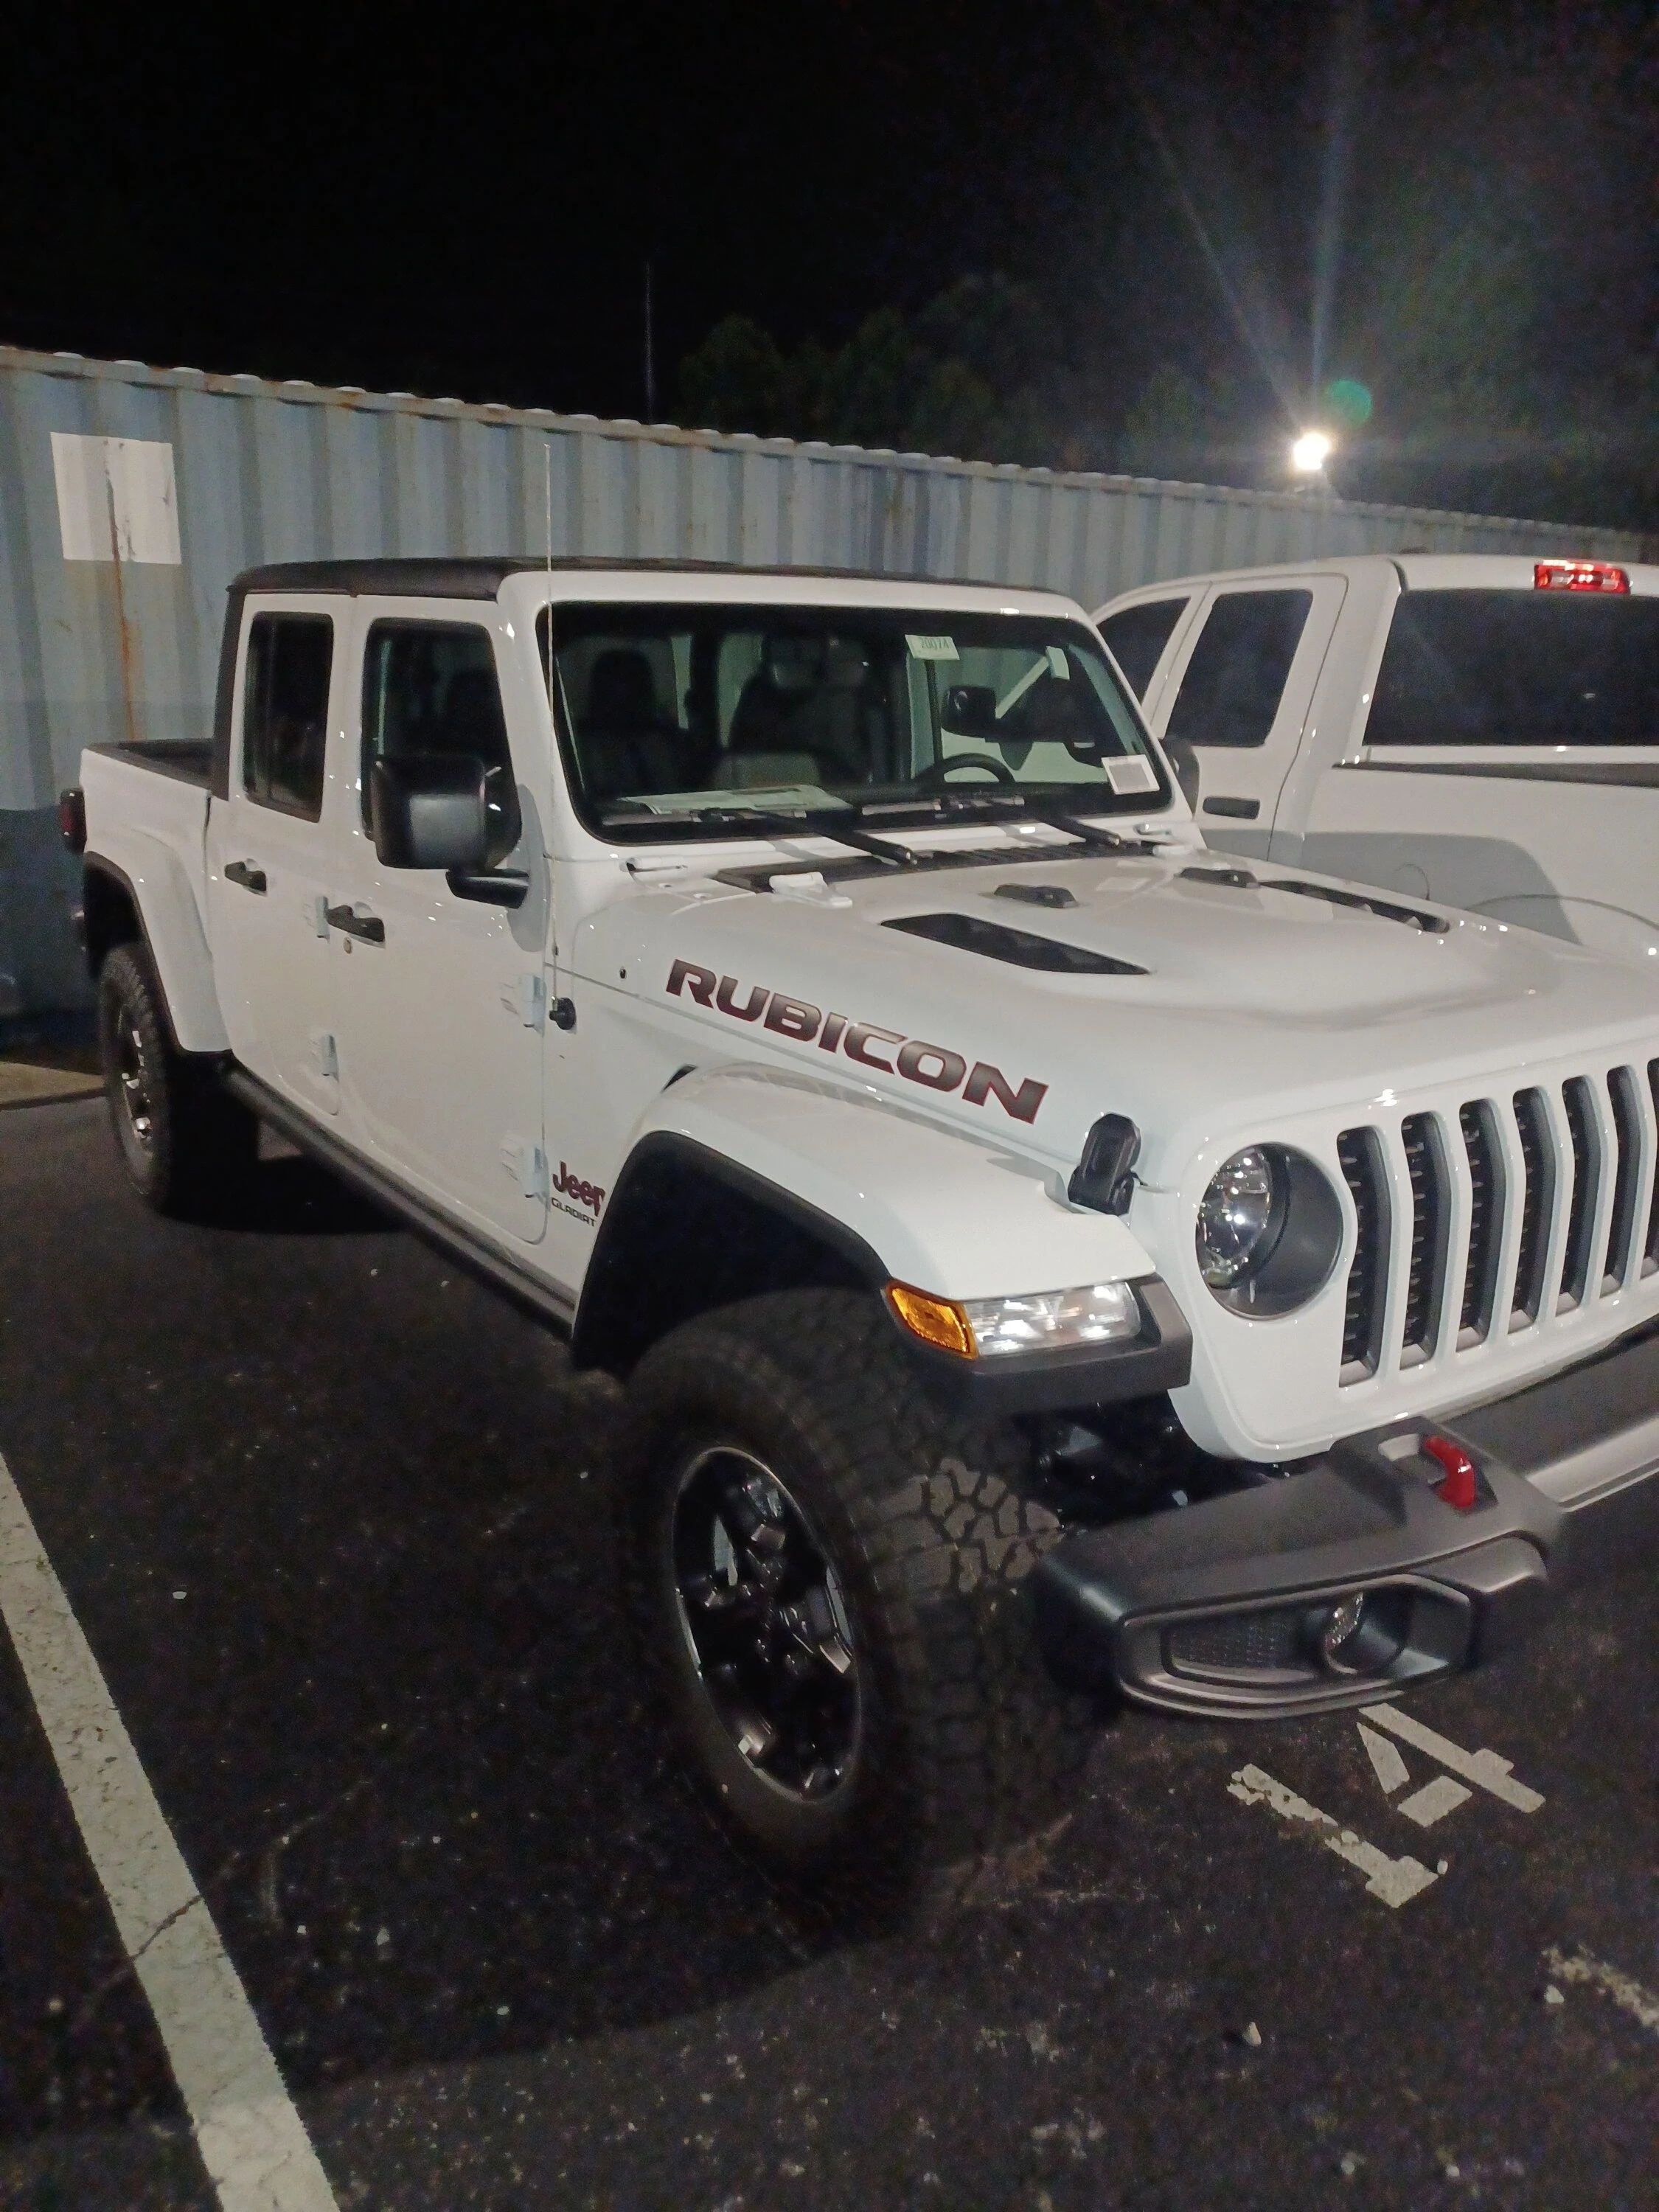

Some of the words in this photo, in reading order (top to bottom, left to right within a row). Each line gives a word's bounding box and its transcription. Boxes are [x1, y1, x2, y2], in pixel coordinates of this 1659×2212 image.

[667, 959, 1048, 1124] RUBICON
[552, 1160, 605, 1217] Jeep
[552, 1197, 596, 1227] GLADIAT
